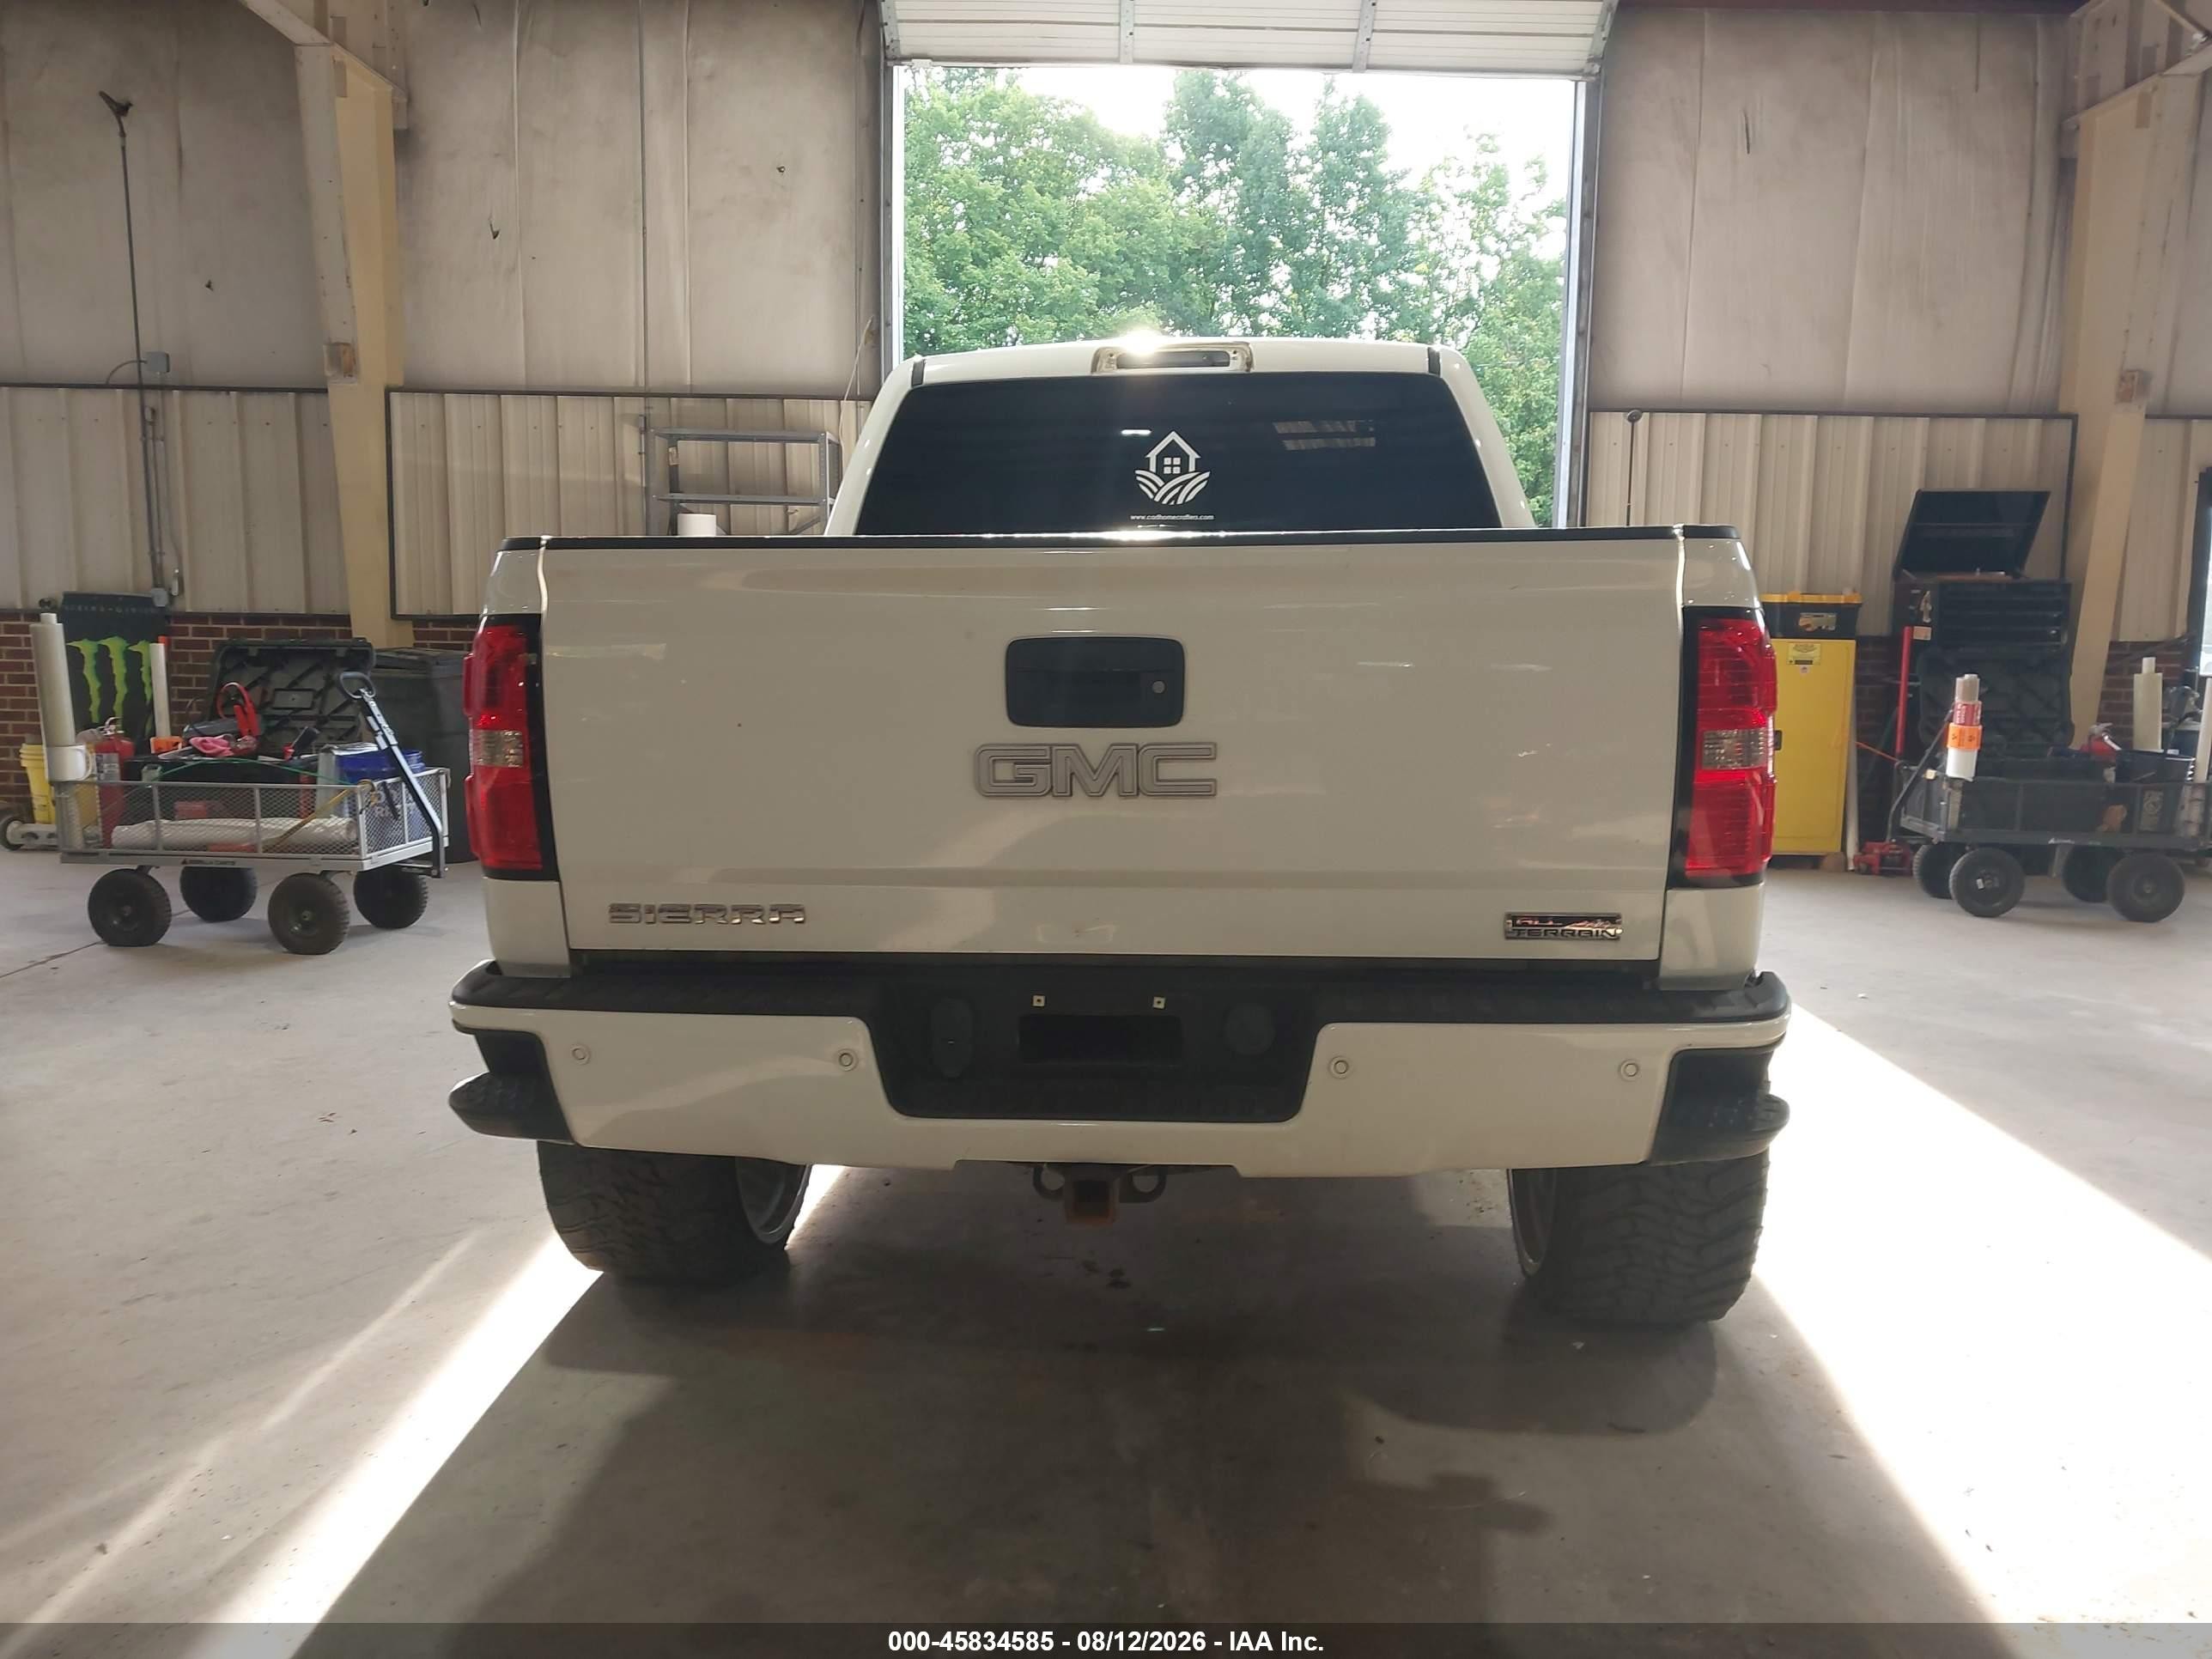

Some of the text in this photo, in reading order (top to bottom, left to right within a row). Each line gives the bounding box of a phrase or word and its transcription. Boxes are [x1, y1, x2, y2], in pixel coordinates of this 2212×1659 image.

[975, 743, 1218, 798] GMC
[608, 902, 805, 925] SIERRA
[1512, 928, 1618, 939] TERRAIN
